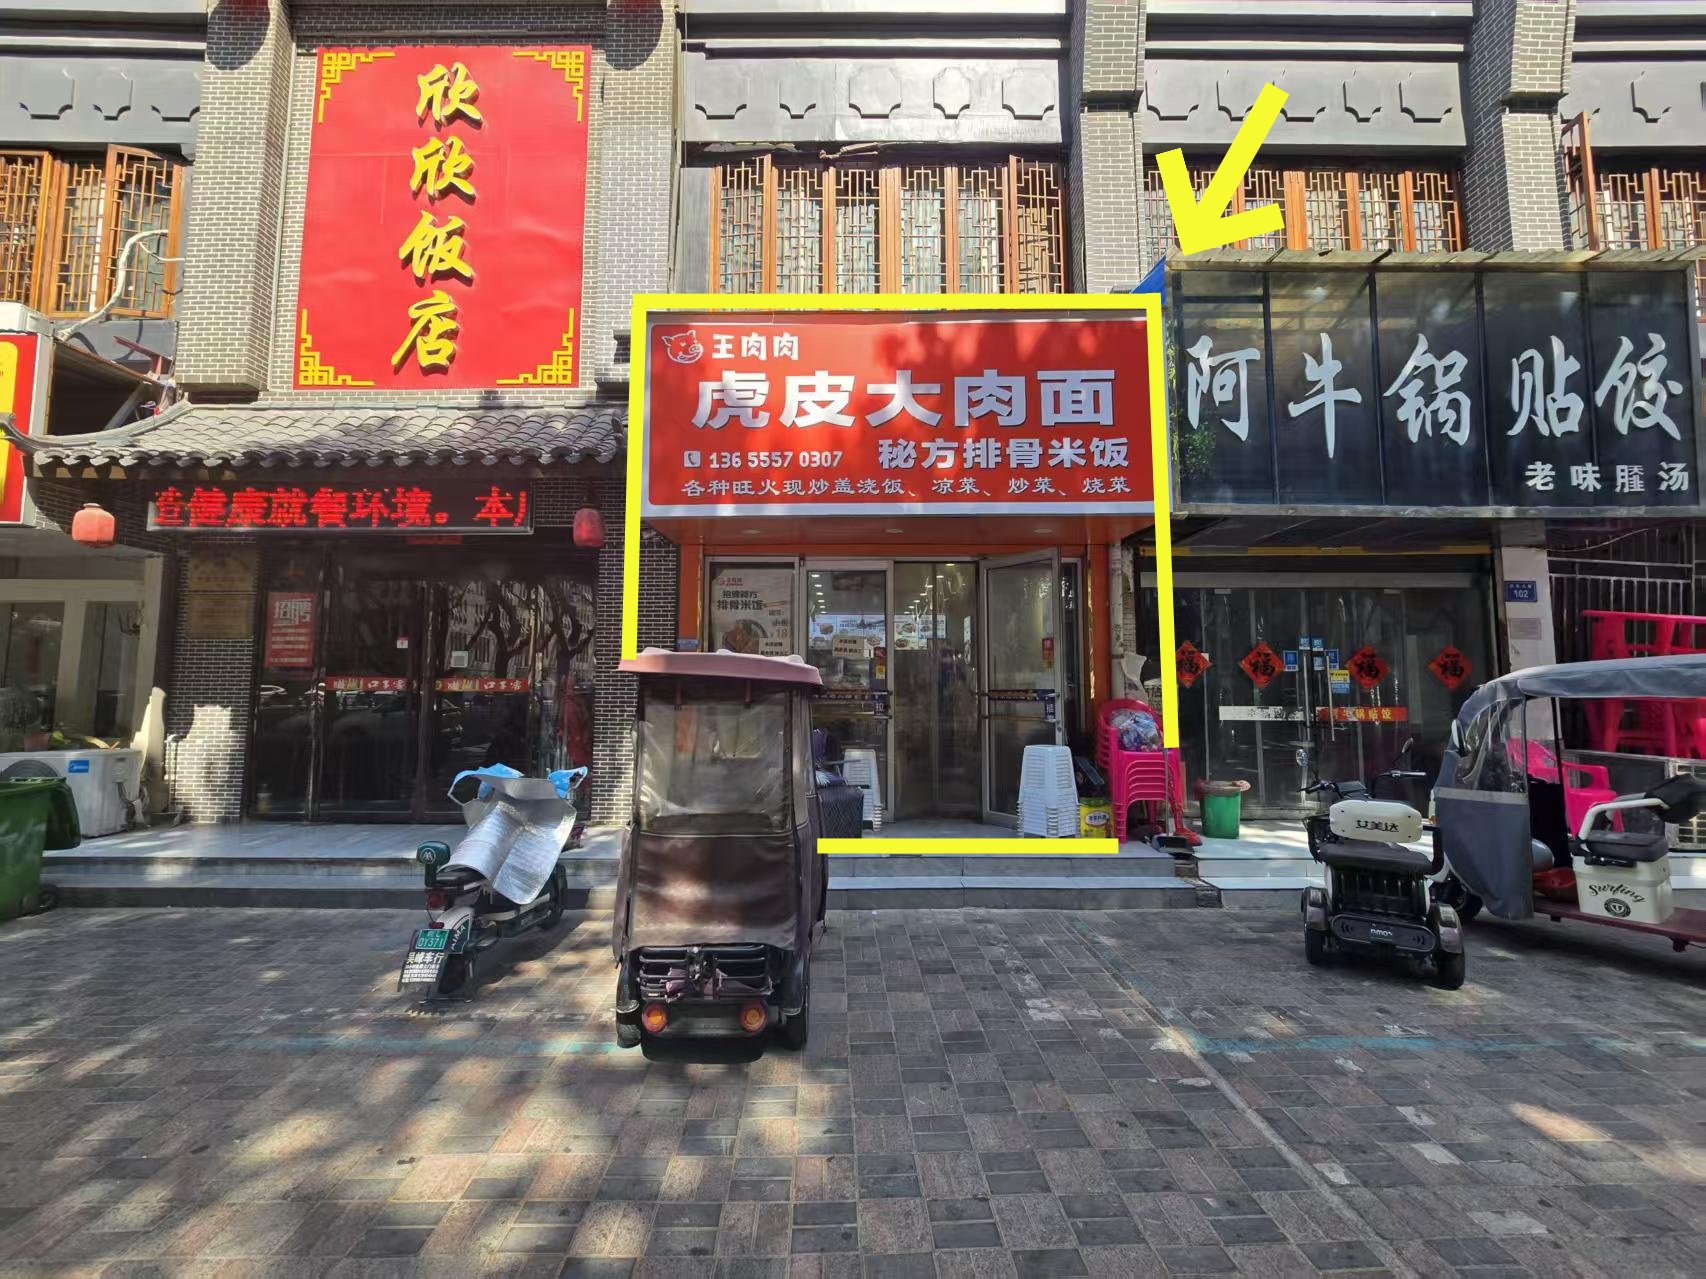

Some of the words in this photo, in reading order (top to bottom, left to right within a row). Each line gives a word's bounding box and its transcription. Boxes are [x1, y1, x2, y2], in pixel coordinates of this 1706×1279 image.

[391, 61, 483, 370] 欣欣饭店
[711, 332, 800, 360] 王肉肉
[691, 368, 1117, 430] 虎皮大肉面
[1186, 331, 1684, 459] 阿牛锅贴饺
[709, 452, 741, 468] 136
[748, 451, 793, 467] 5557
[799, 451, 842, 467] 0307
[878, 437, 1130, 470] 秘方排骨米饭
[1513, 589, 1529, 598] 102
[1588, 884, 1647, 902] Surfing
